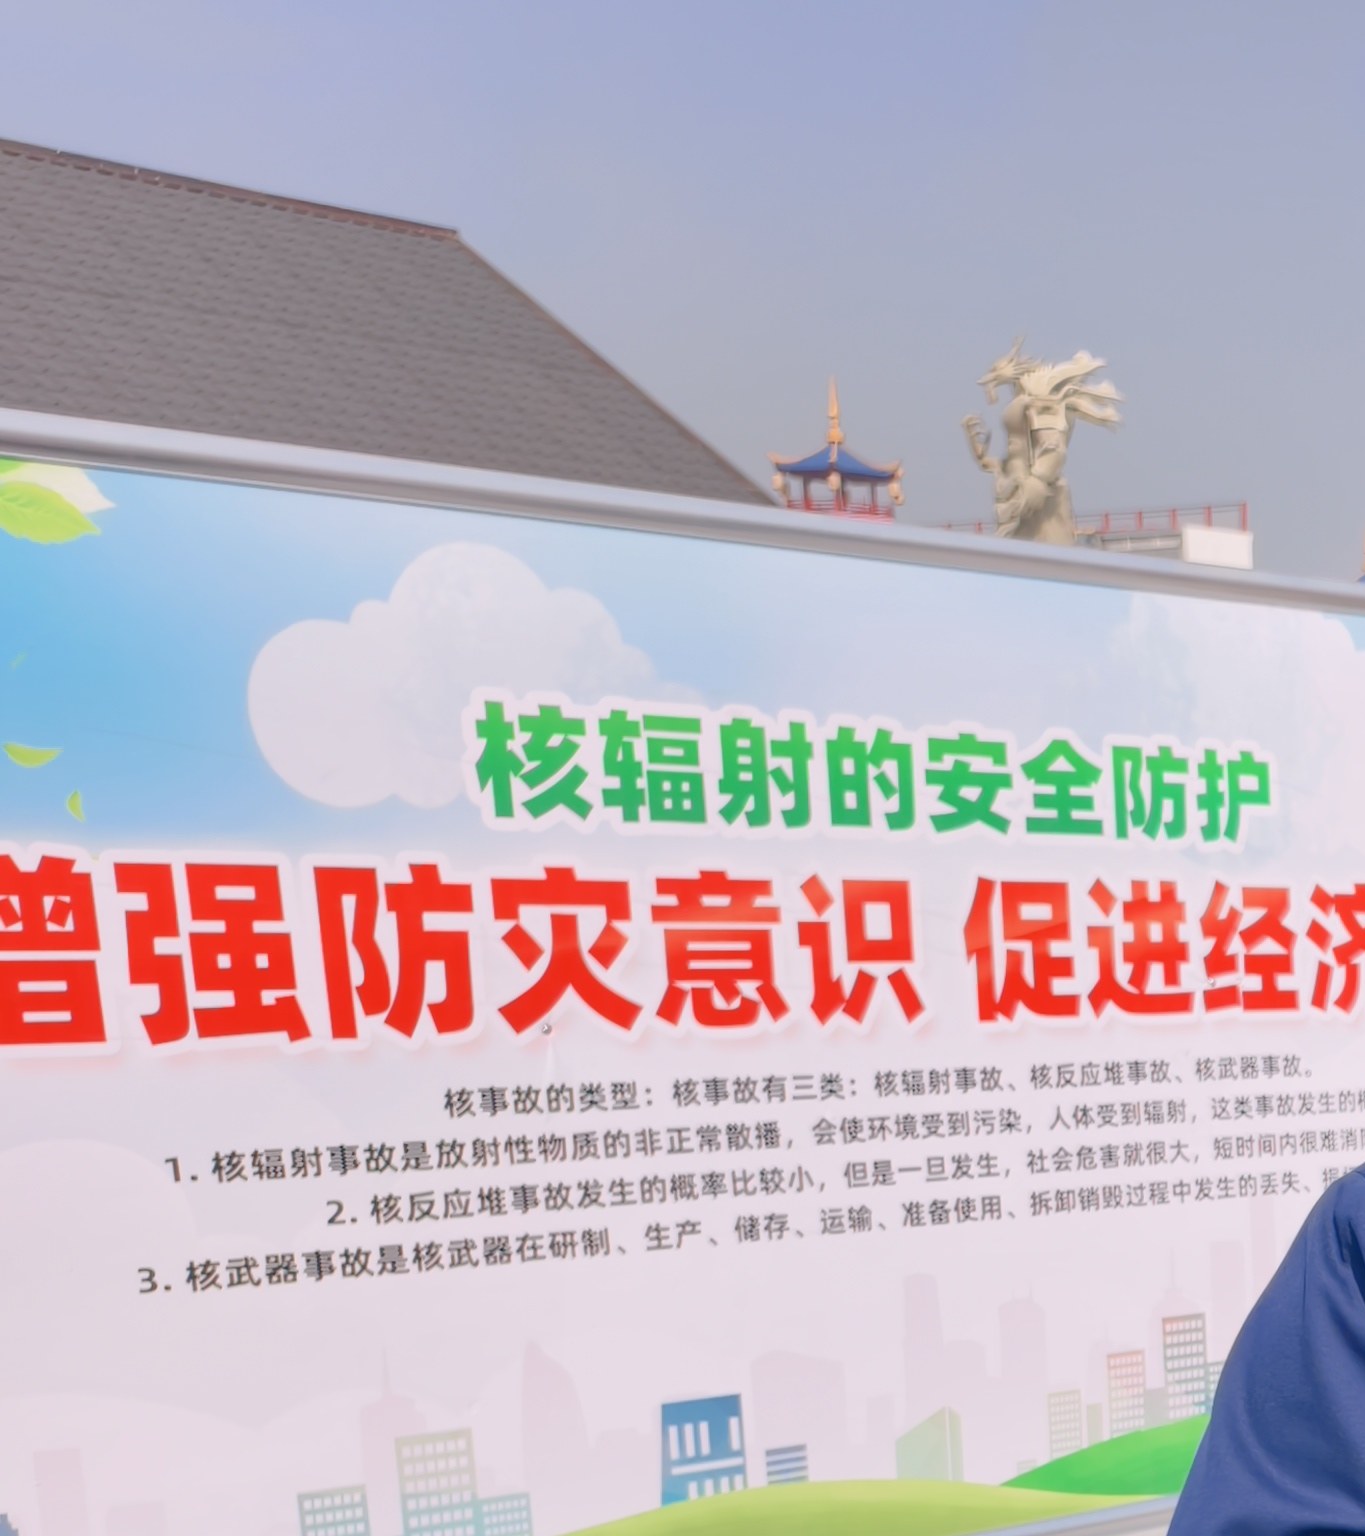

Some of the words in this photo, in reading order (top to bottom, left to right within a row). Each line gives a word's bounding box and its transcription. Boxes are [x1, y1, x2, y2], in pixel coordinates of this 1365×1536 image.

[475, 700, 1271, 843] 核辐射的安全防护
